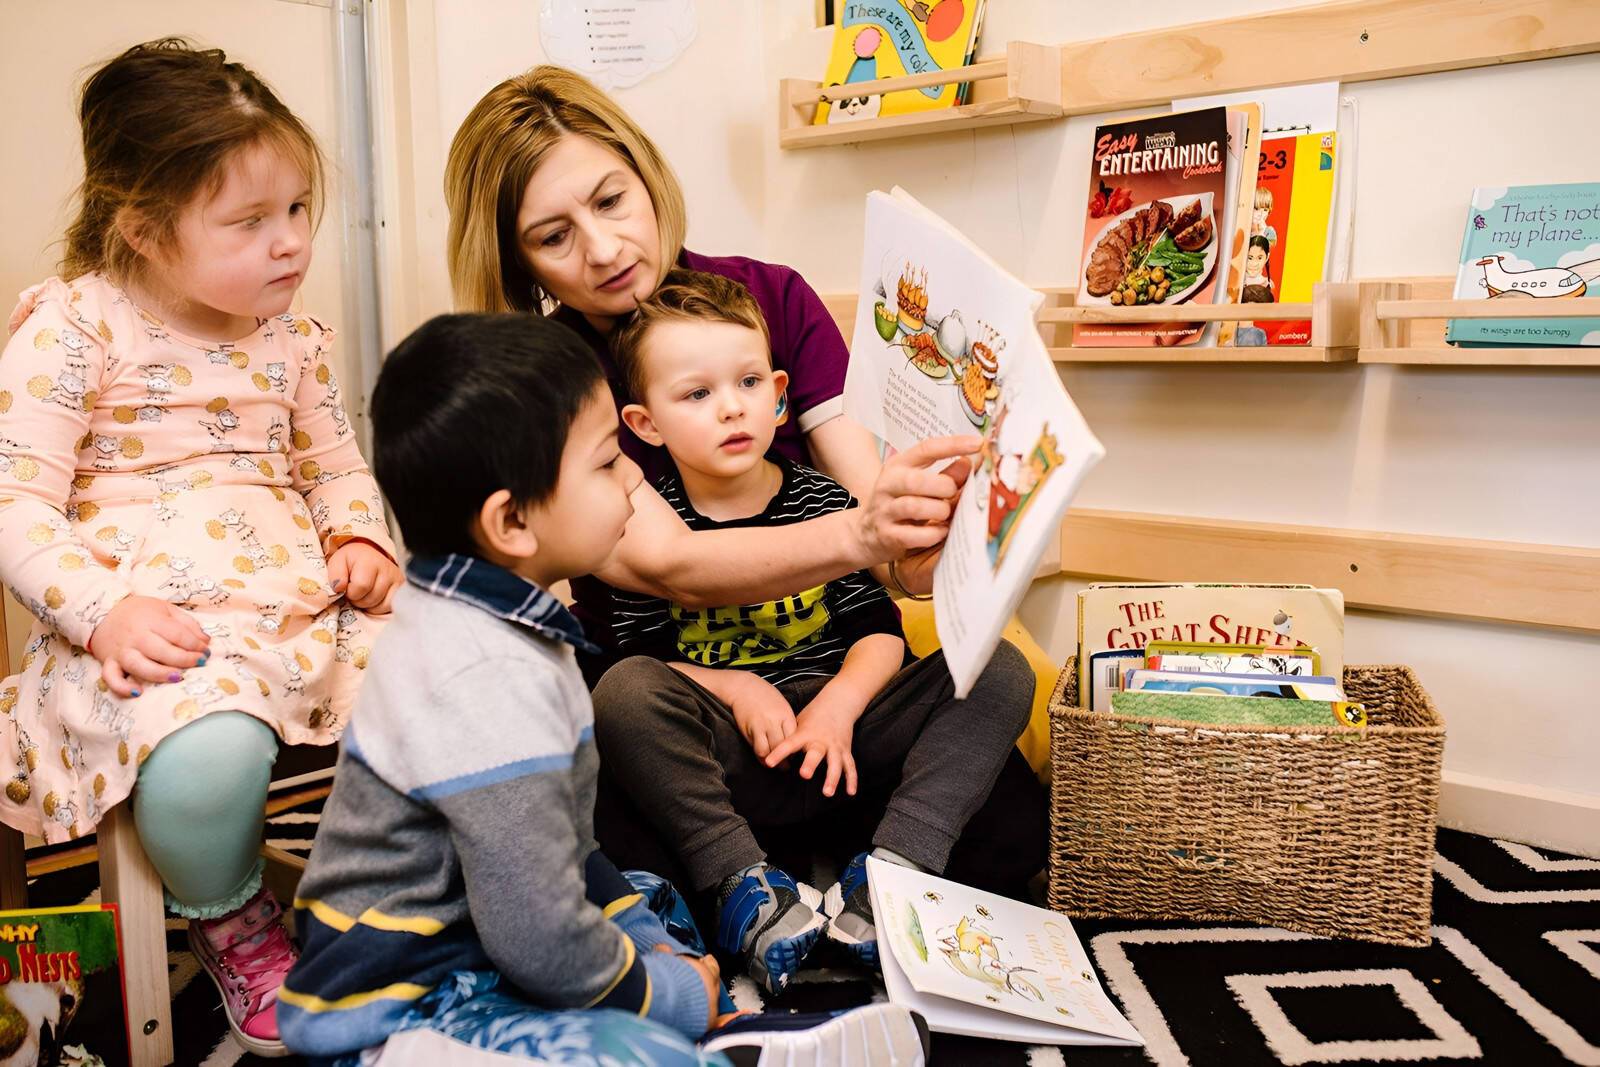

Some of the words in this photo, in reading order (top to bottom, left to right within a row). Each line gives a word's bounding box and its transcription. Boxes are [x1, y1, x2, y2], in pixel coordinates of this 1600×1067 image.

[848, 4, 886, 19] These
[886, 12, 903, 30] are
[900, 29, 915, 51] my
[1095, 133, 1138, 161] Easy
[1099, 140, 1220, 176] ENTERTAINING
[1182, 160, 1223, 179] Cookbook
[1501, 203, 1558, 222] That's
[1564, 204, 1600, 221] not
[1492, 230, 1522, 248] my
[1279, 332, 1308, 341] numbers
[1527, 327, 1542, 335] too
[1119, 600, 1166, 627] THE
[1107, 623, 1202, 649] GREAT
[16, 943, 81, 984] NESTS
